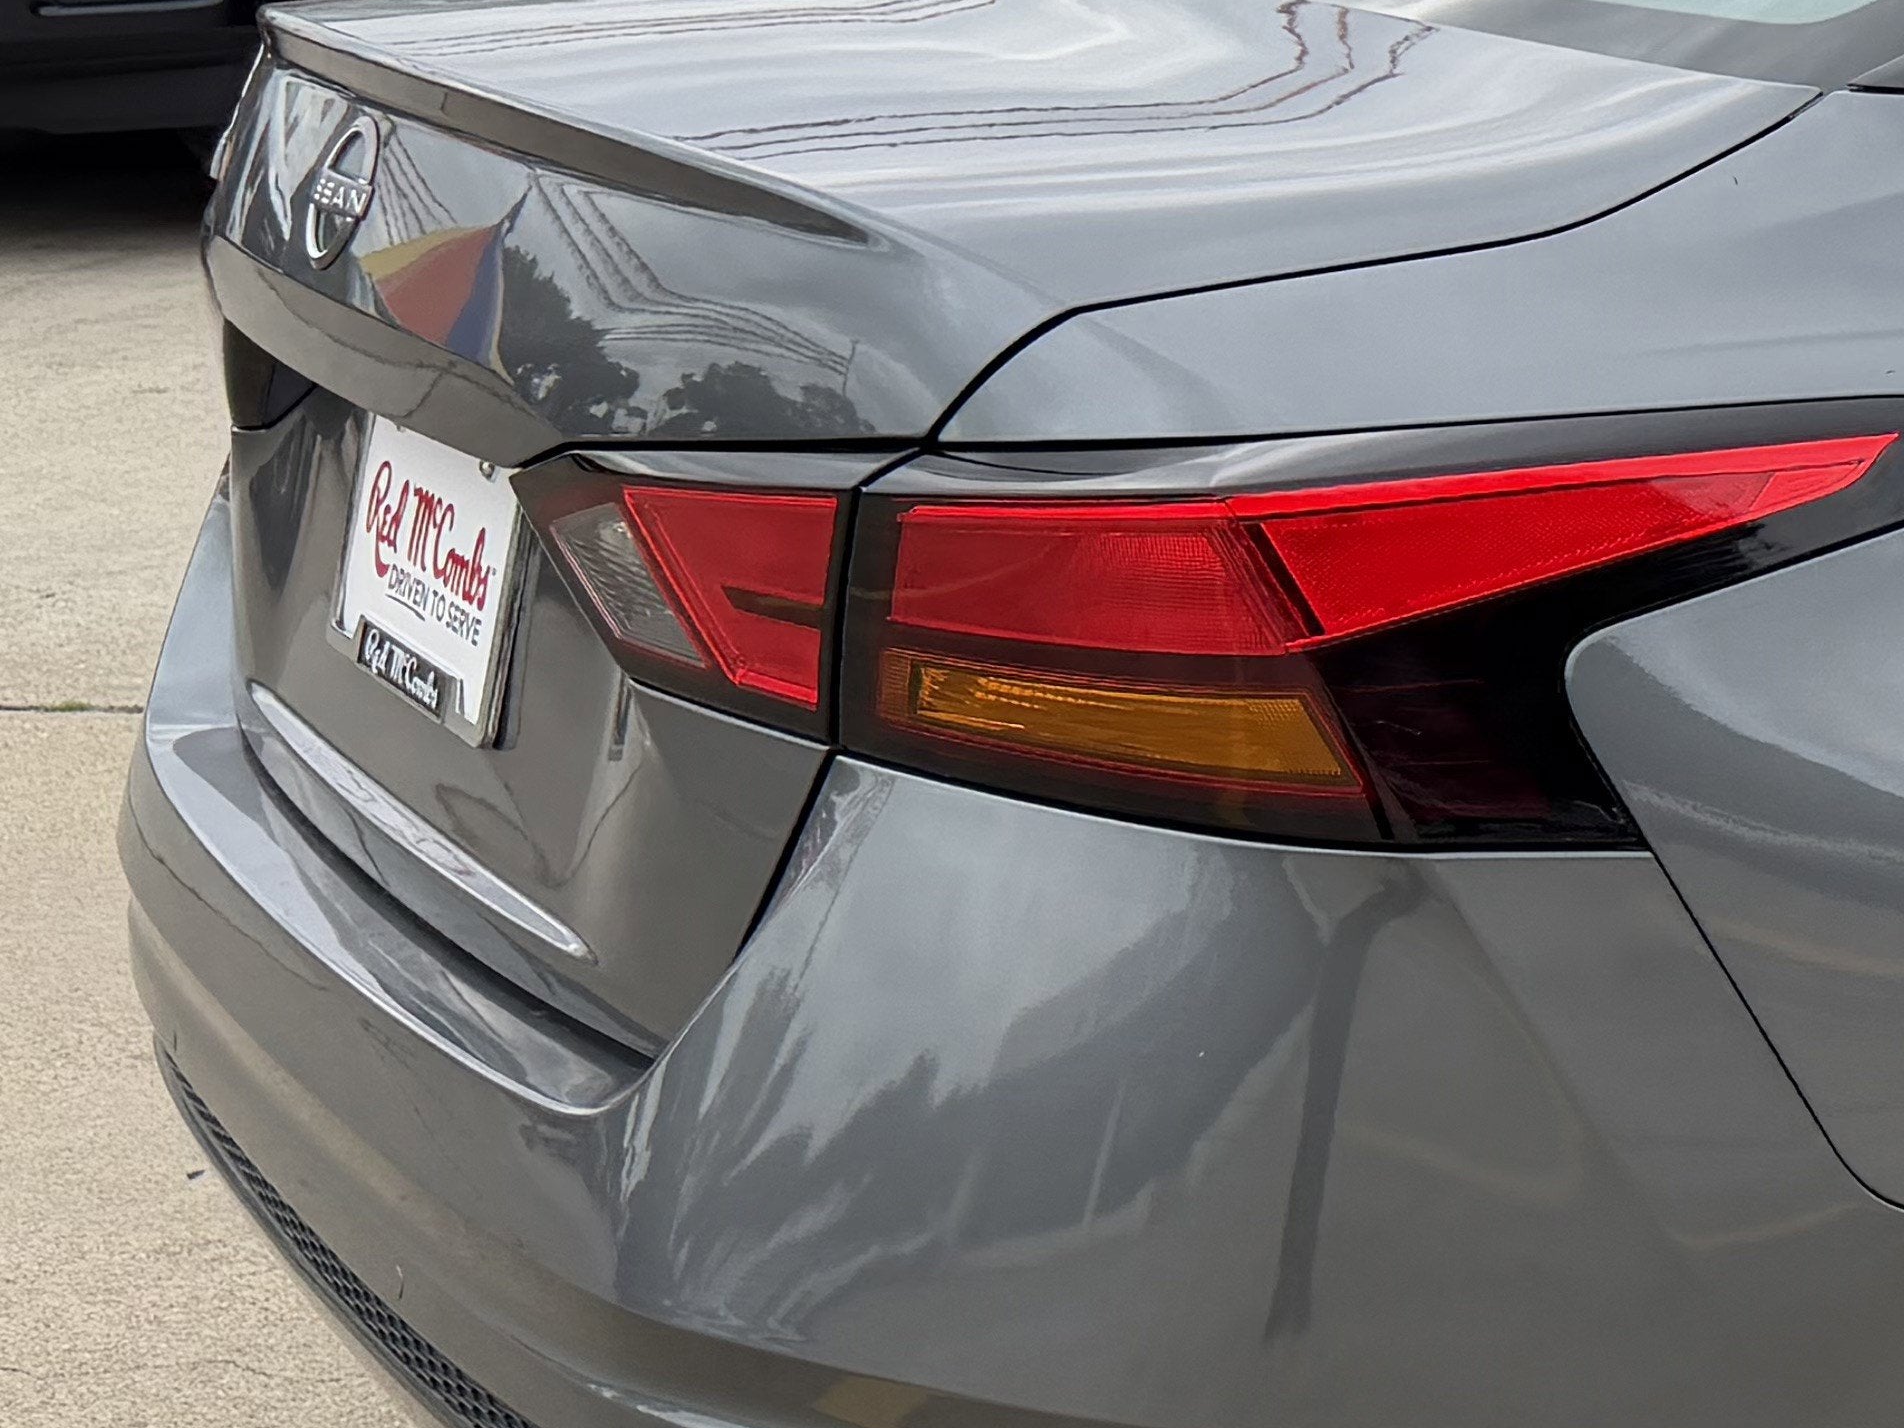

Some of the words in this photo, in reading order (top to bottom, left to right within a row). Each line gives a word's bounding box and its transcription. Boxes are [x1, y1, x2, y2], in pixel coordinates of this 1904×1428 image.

[366, 460, 409, 578] Red
[407, 486, 491, 611] McCombs
[387, 563, 430, 612] DRIVEN
[430, 589, 446, 622] TO
[445, 601, 483, 647] SERVE
[365, 628, 391, 674] Red
